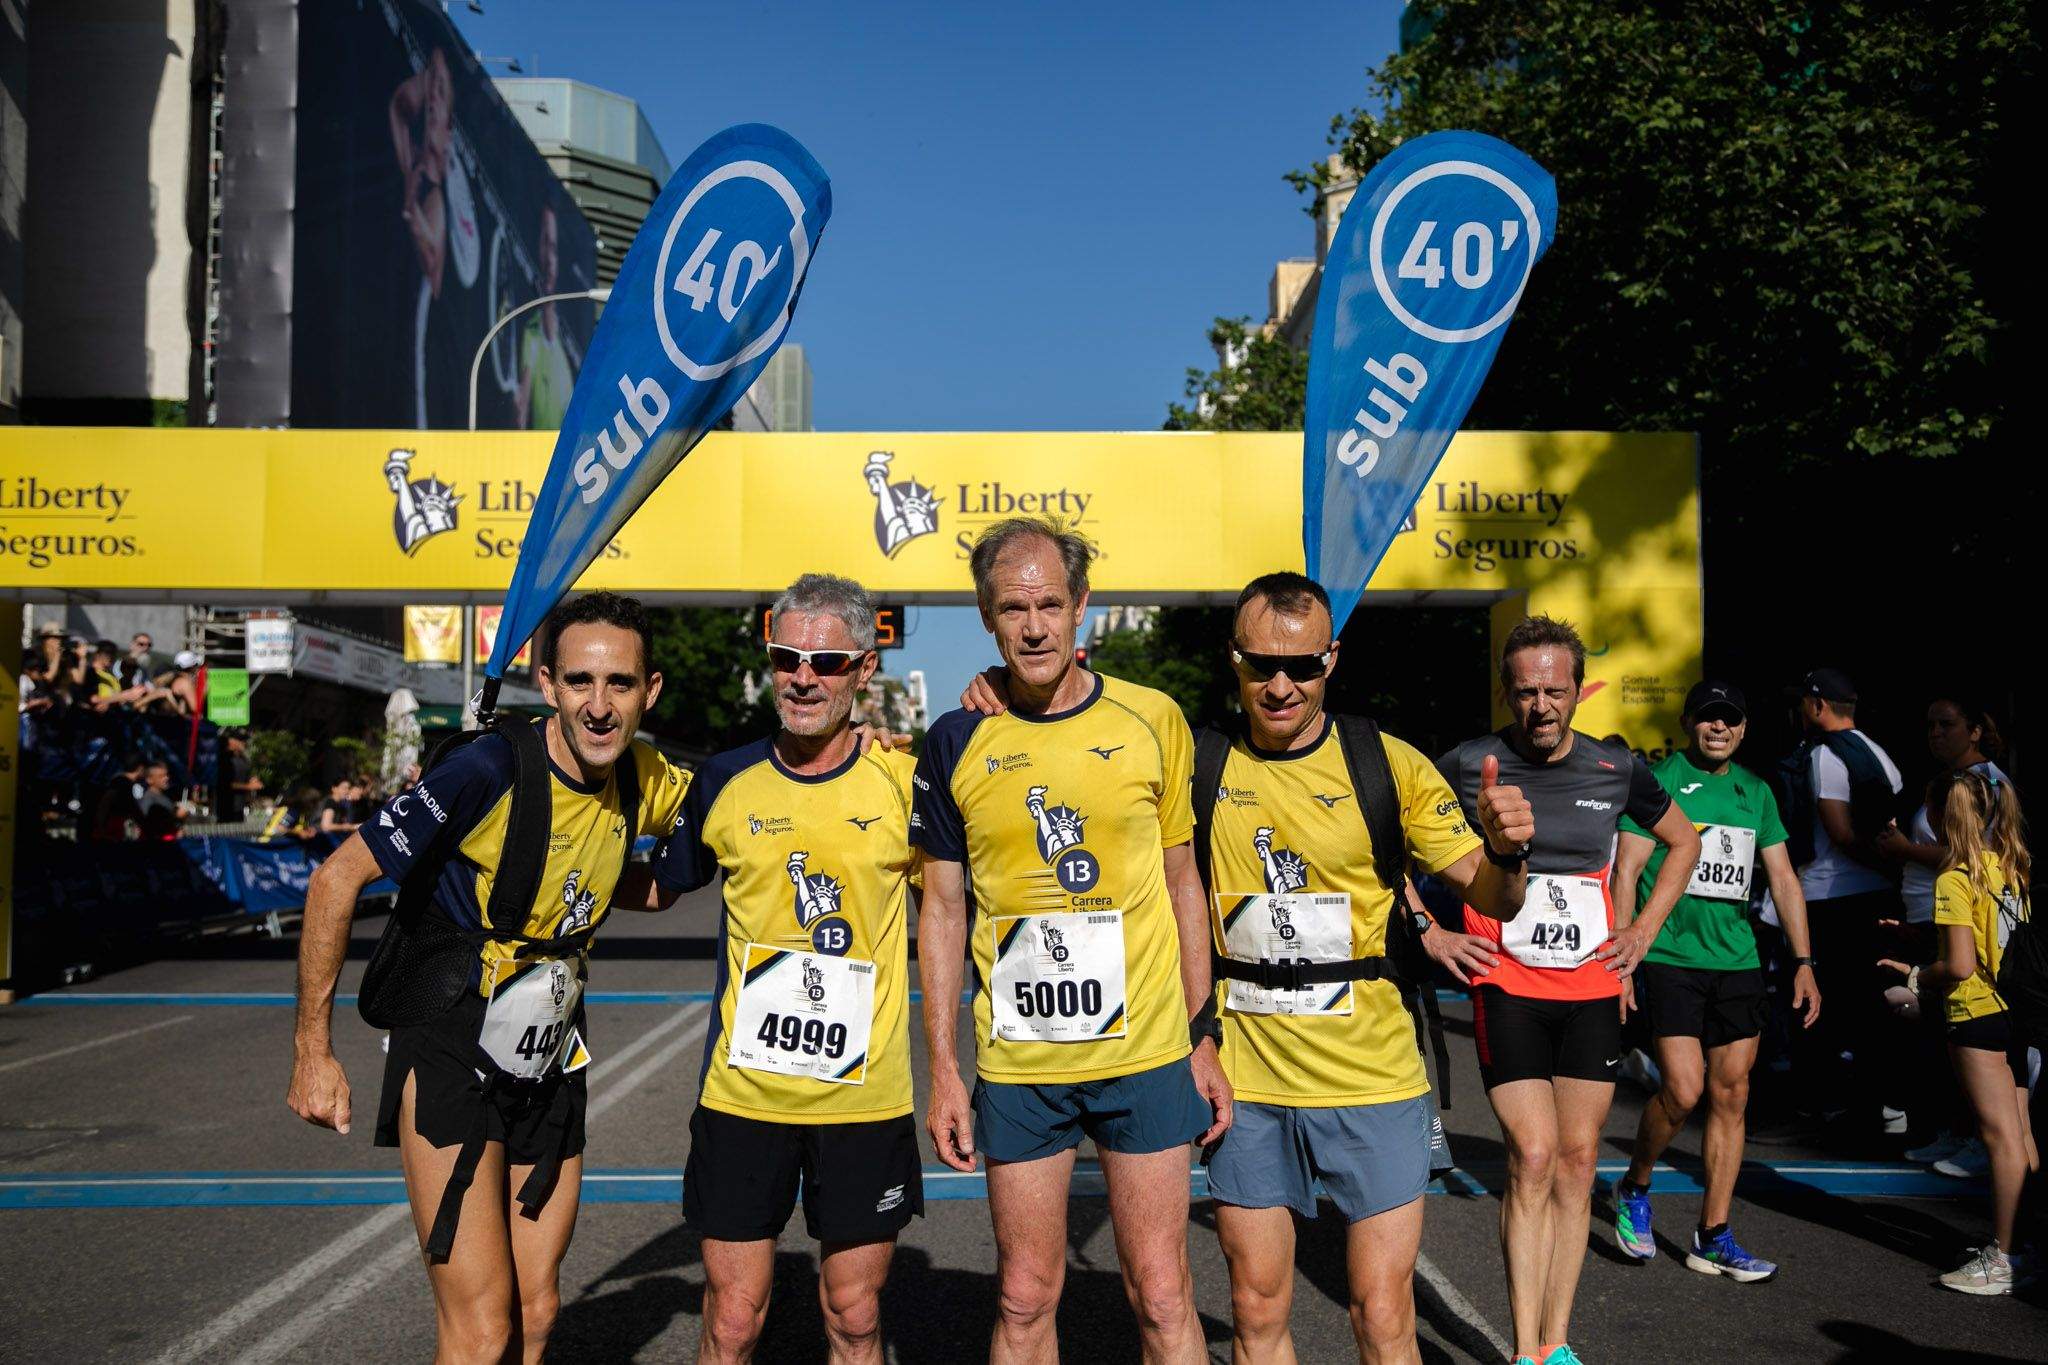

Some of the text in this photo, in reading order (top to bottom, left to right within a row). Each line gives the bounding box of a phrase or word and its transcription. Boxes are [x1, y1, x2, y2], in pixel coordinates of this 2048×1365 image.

[1337, 353, 1428, 479] sub
[574, 374, 671, 504] sub
[957, 482, 1093, 527] Liberty
[1435, 481, 1568, 527] Liberty
[1002, 752, 1029, 764] Liberty
[417, 785, 448, 823] MADRID
[1065, 860, 1092, 882] 13
[1698, 862, 1745, 887] 3824
[1071, 896, 1112, 906] Carrera
[820, 928, 846, 950] 13
[1282, 927, 1293, 937] 13
[1531, 922, 1581, 952] 429
[1054, 948, 1066, 959] 13
[811, 988, 821, 998] 13
[1015, 978, 1102, 1018] 5000
[515, 1020, 564, 1061] 443
[757, 1012, 847, 1059] 4999
